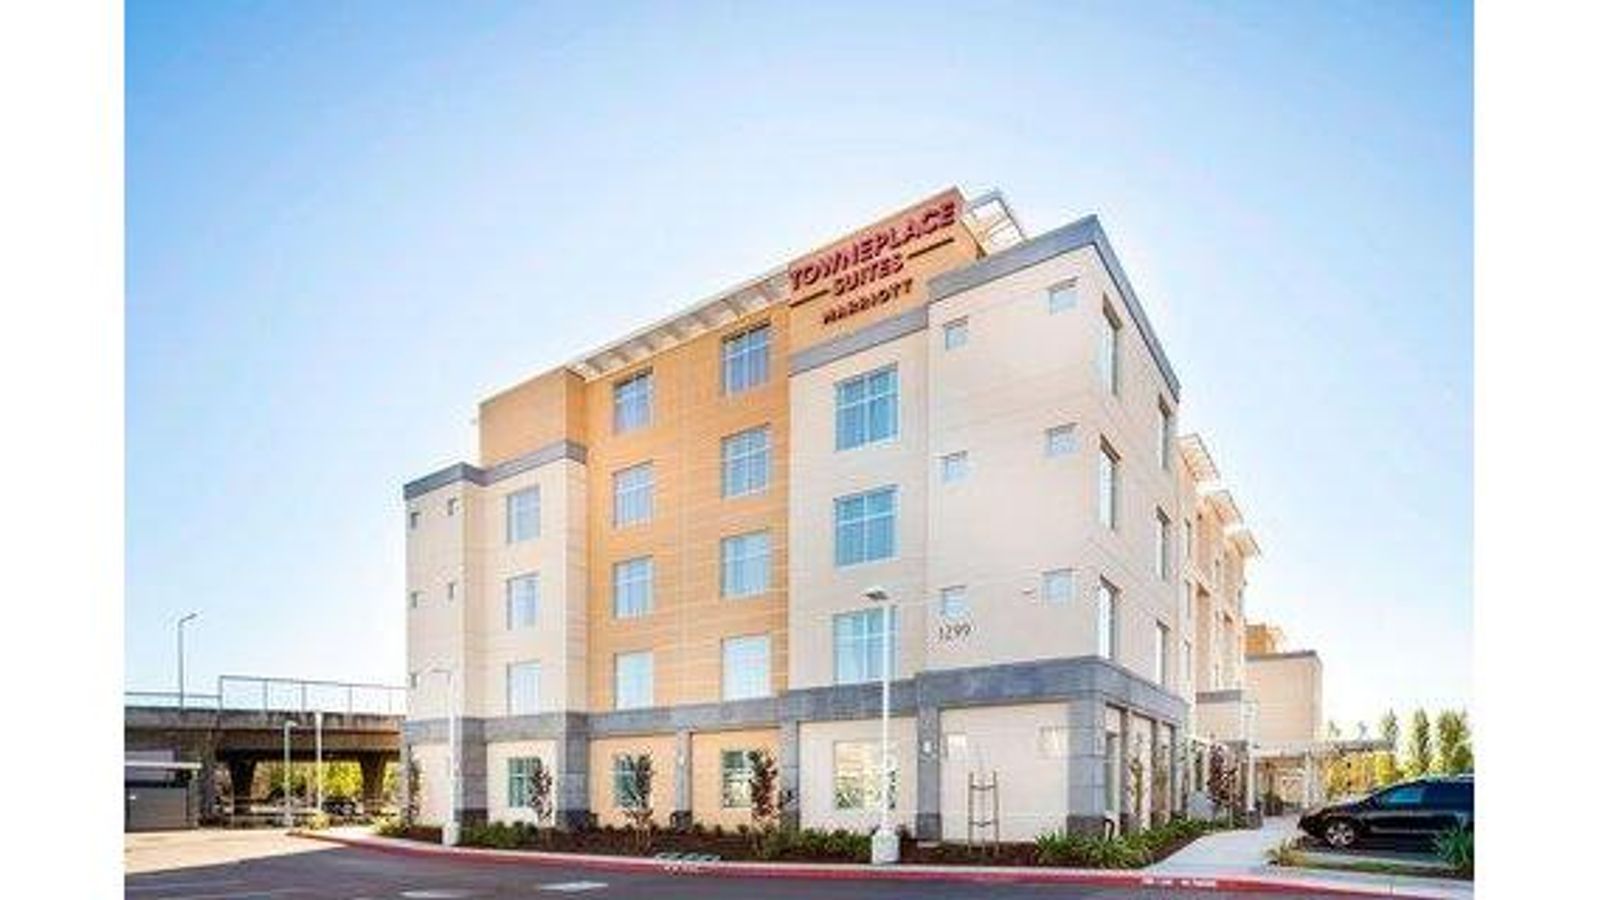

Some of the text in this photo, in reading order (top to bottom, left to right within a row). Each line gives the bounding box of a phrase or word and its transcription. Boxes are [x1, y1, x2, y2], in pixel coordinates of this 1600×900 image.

[788, 201, 957, 291] TOWNEPLACE
[832, 253, 905, 296] SUITES
[822, 278, 914, 324] MARRIOTT
[938, 623, 972, 643] 1299
